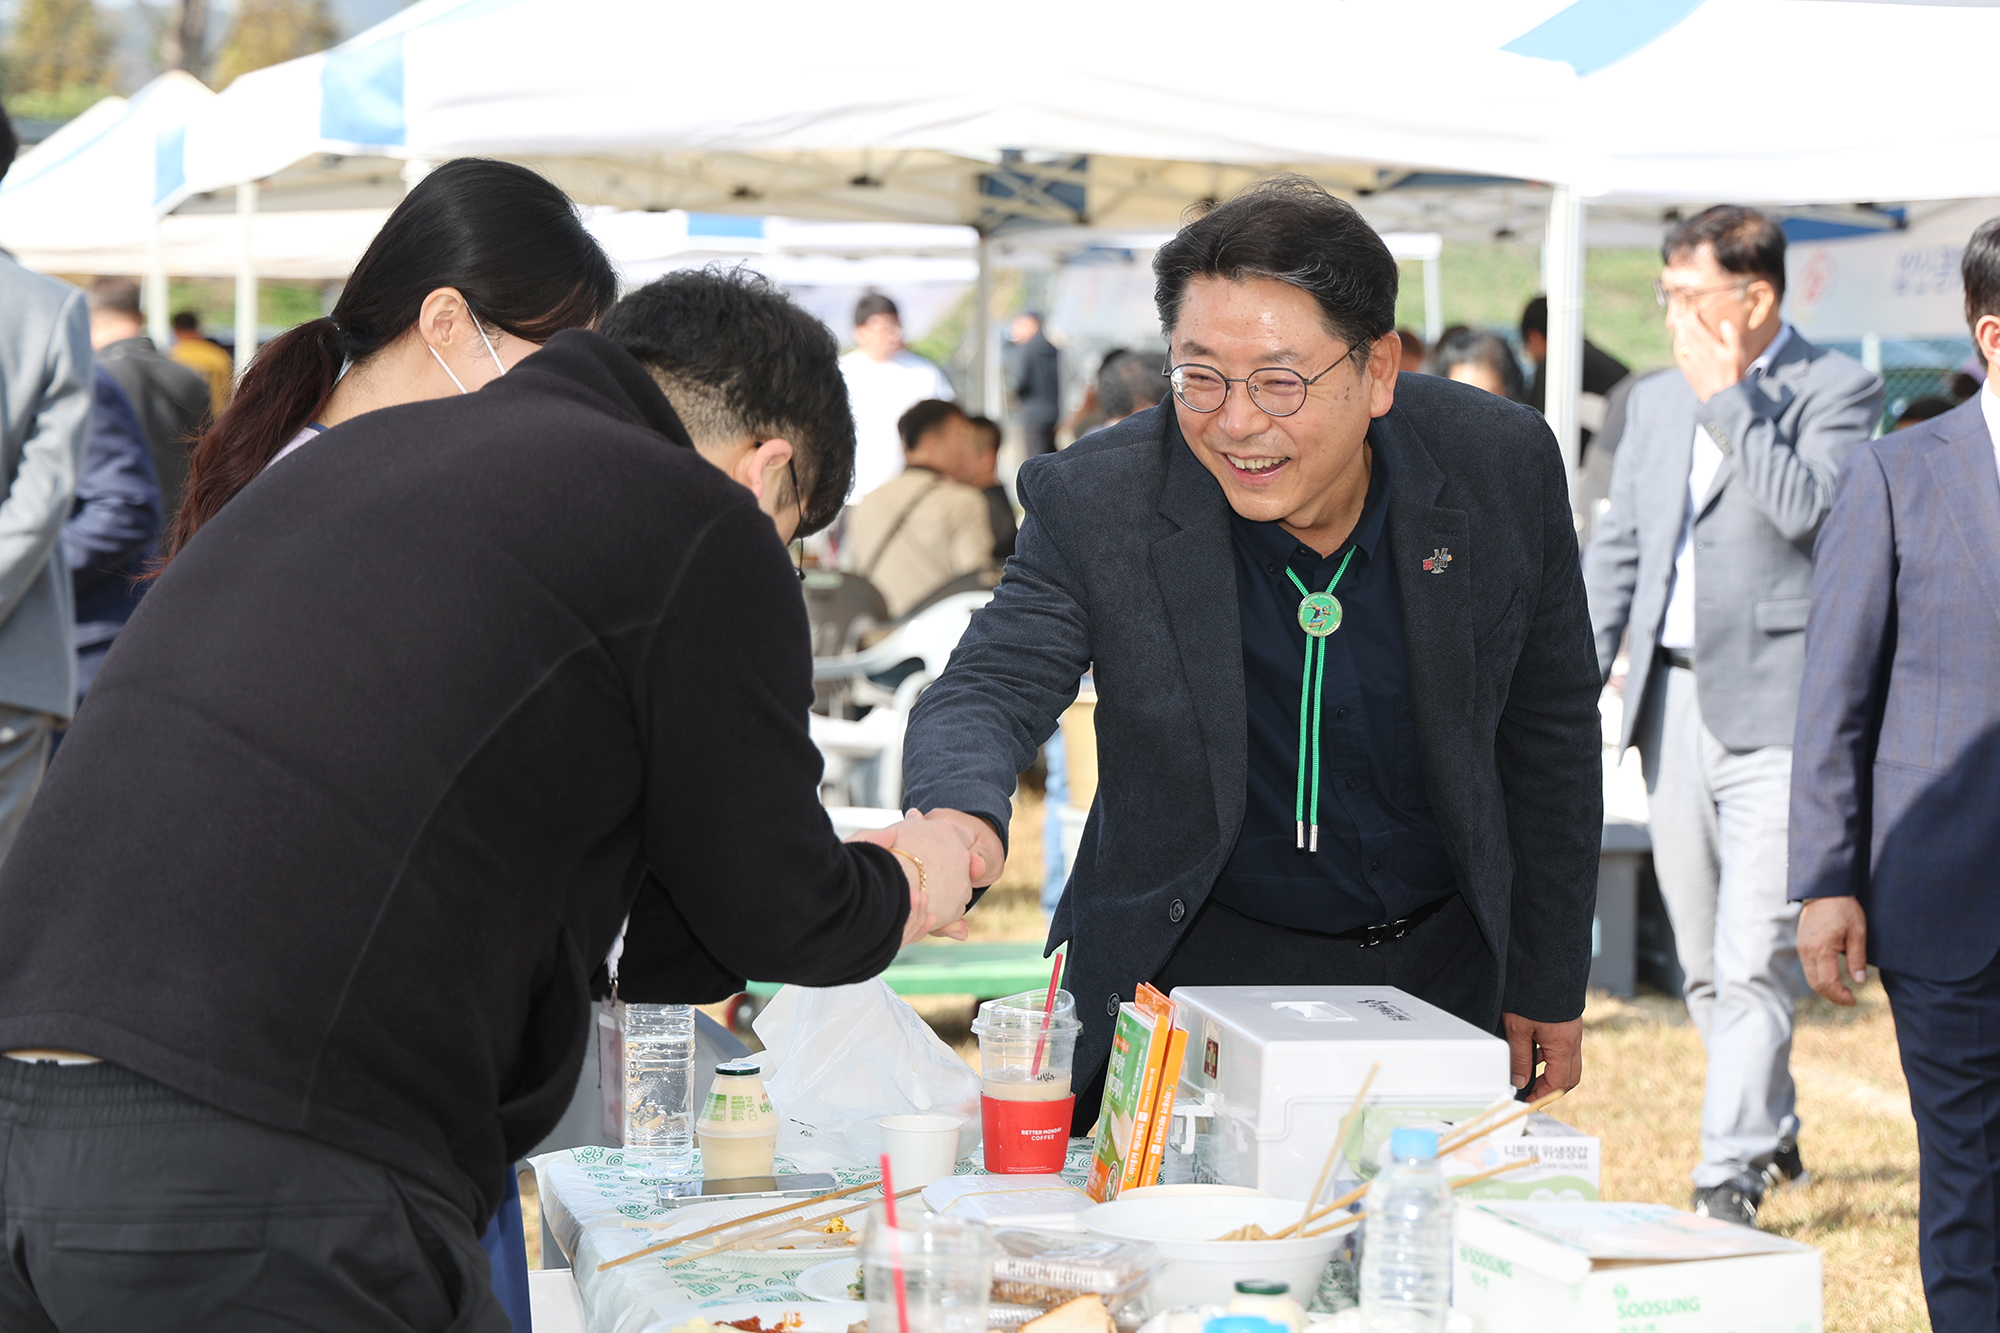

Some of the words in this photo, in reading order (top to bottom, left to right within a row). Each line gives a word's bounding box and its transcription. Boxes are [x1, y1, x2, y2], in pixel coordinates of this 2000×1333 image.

[1043, 1126, 1062, 1134] MONDAY
[1504, 1144, 1539, 1158] 니트릴
[1542, 1145, 1588, 1160] 위생장갑
[1559, 1162, 1588, 1170] GLOVES
[1469, 1248, 1513, 1279] SOOSUNG
[1616, 1295, 1701, 1320] SOOSUNG
